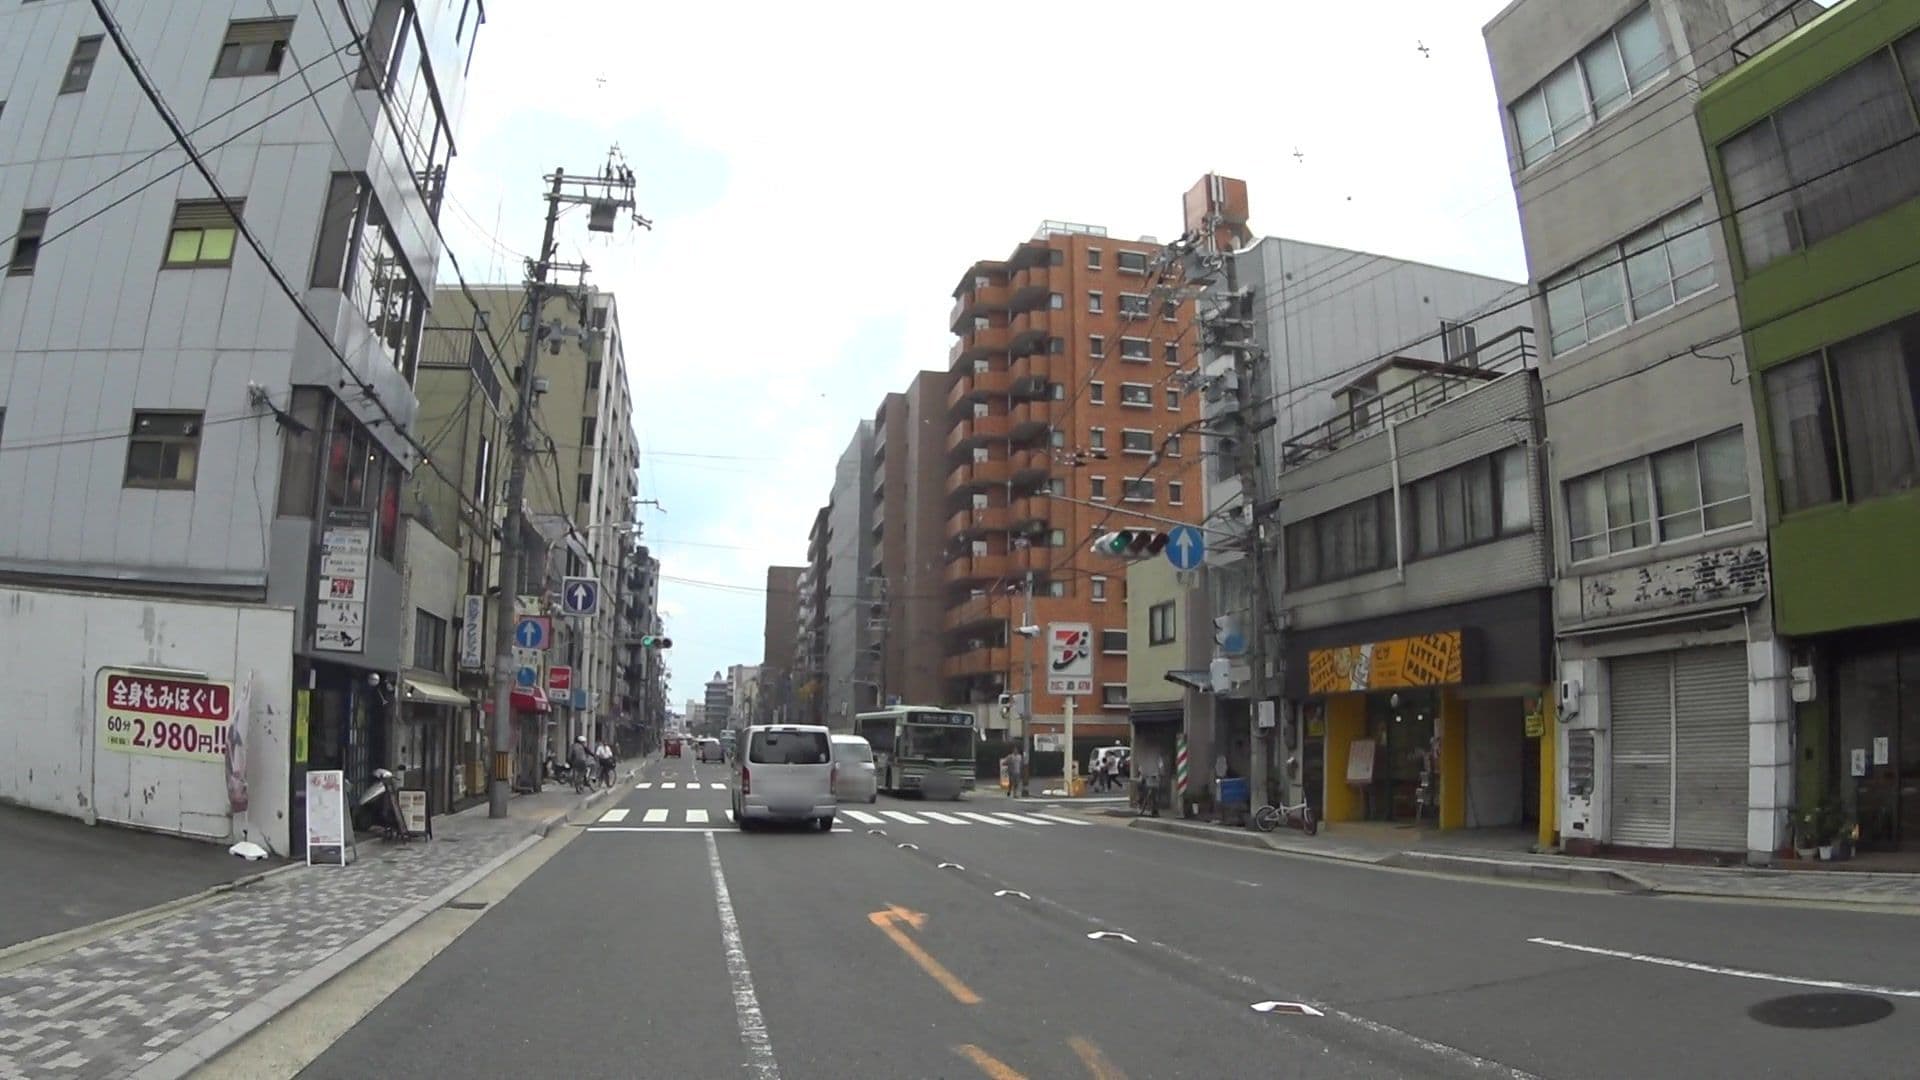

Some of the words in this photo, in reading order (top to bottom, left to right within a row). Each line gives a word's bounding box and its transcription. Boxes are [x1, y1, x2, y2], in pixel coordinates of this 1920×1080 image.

[1410, 641, 1444, 672] LITTLE
[1420, 633, 1447, 656] IZZA
[112, 680, 223, 715] 全身もみほぐし
[107, 716, 131, 732] 60分
[133, 718, 226, 754] 2,980円!!
